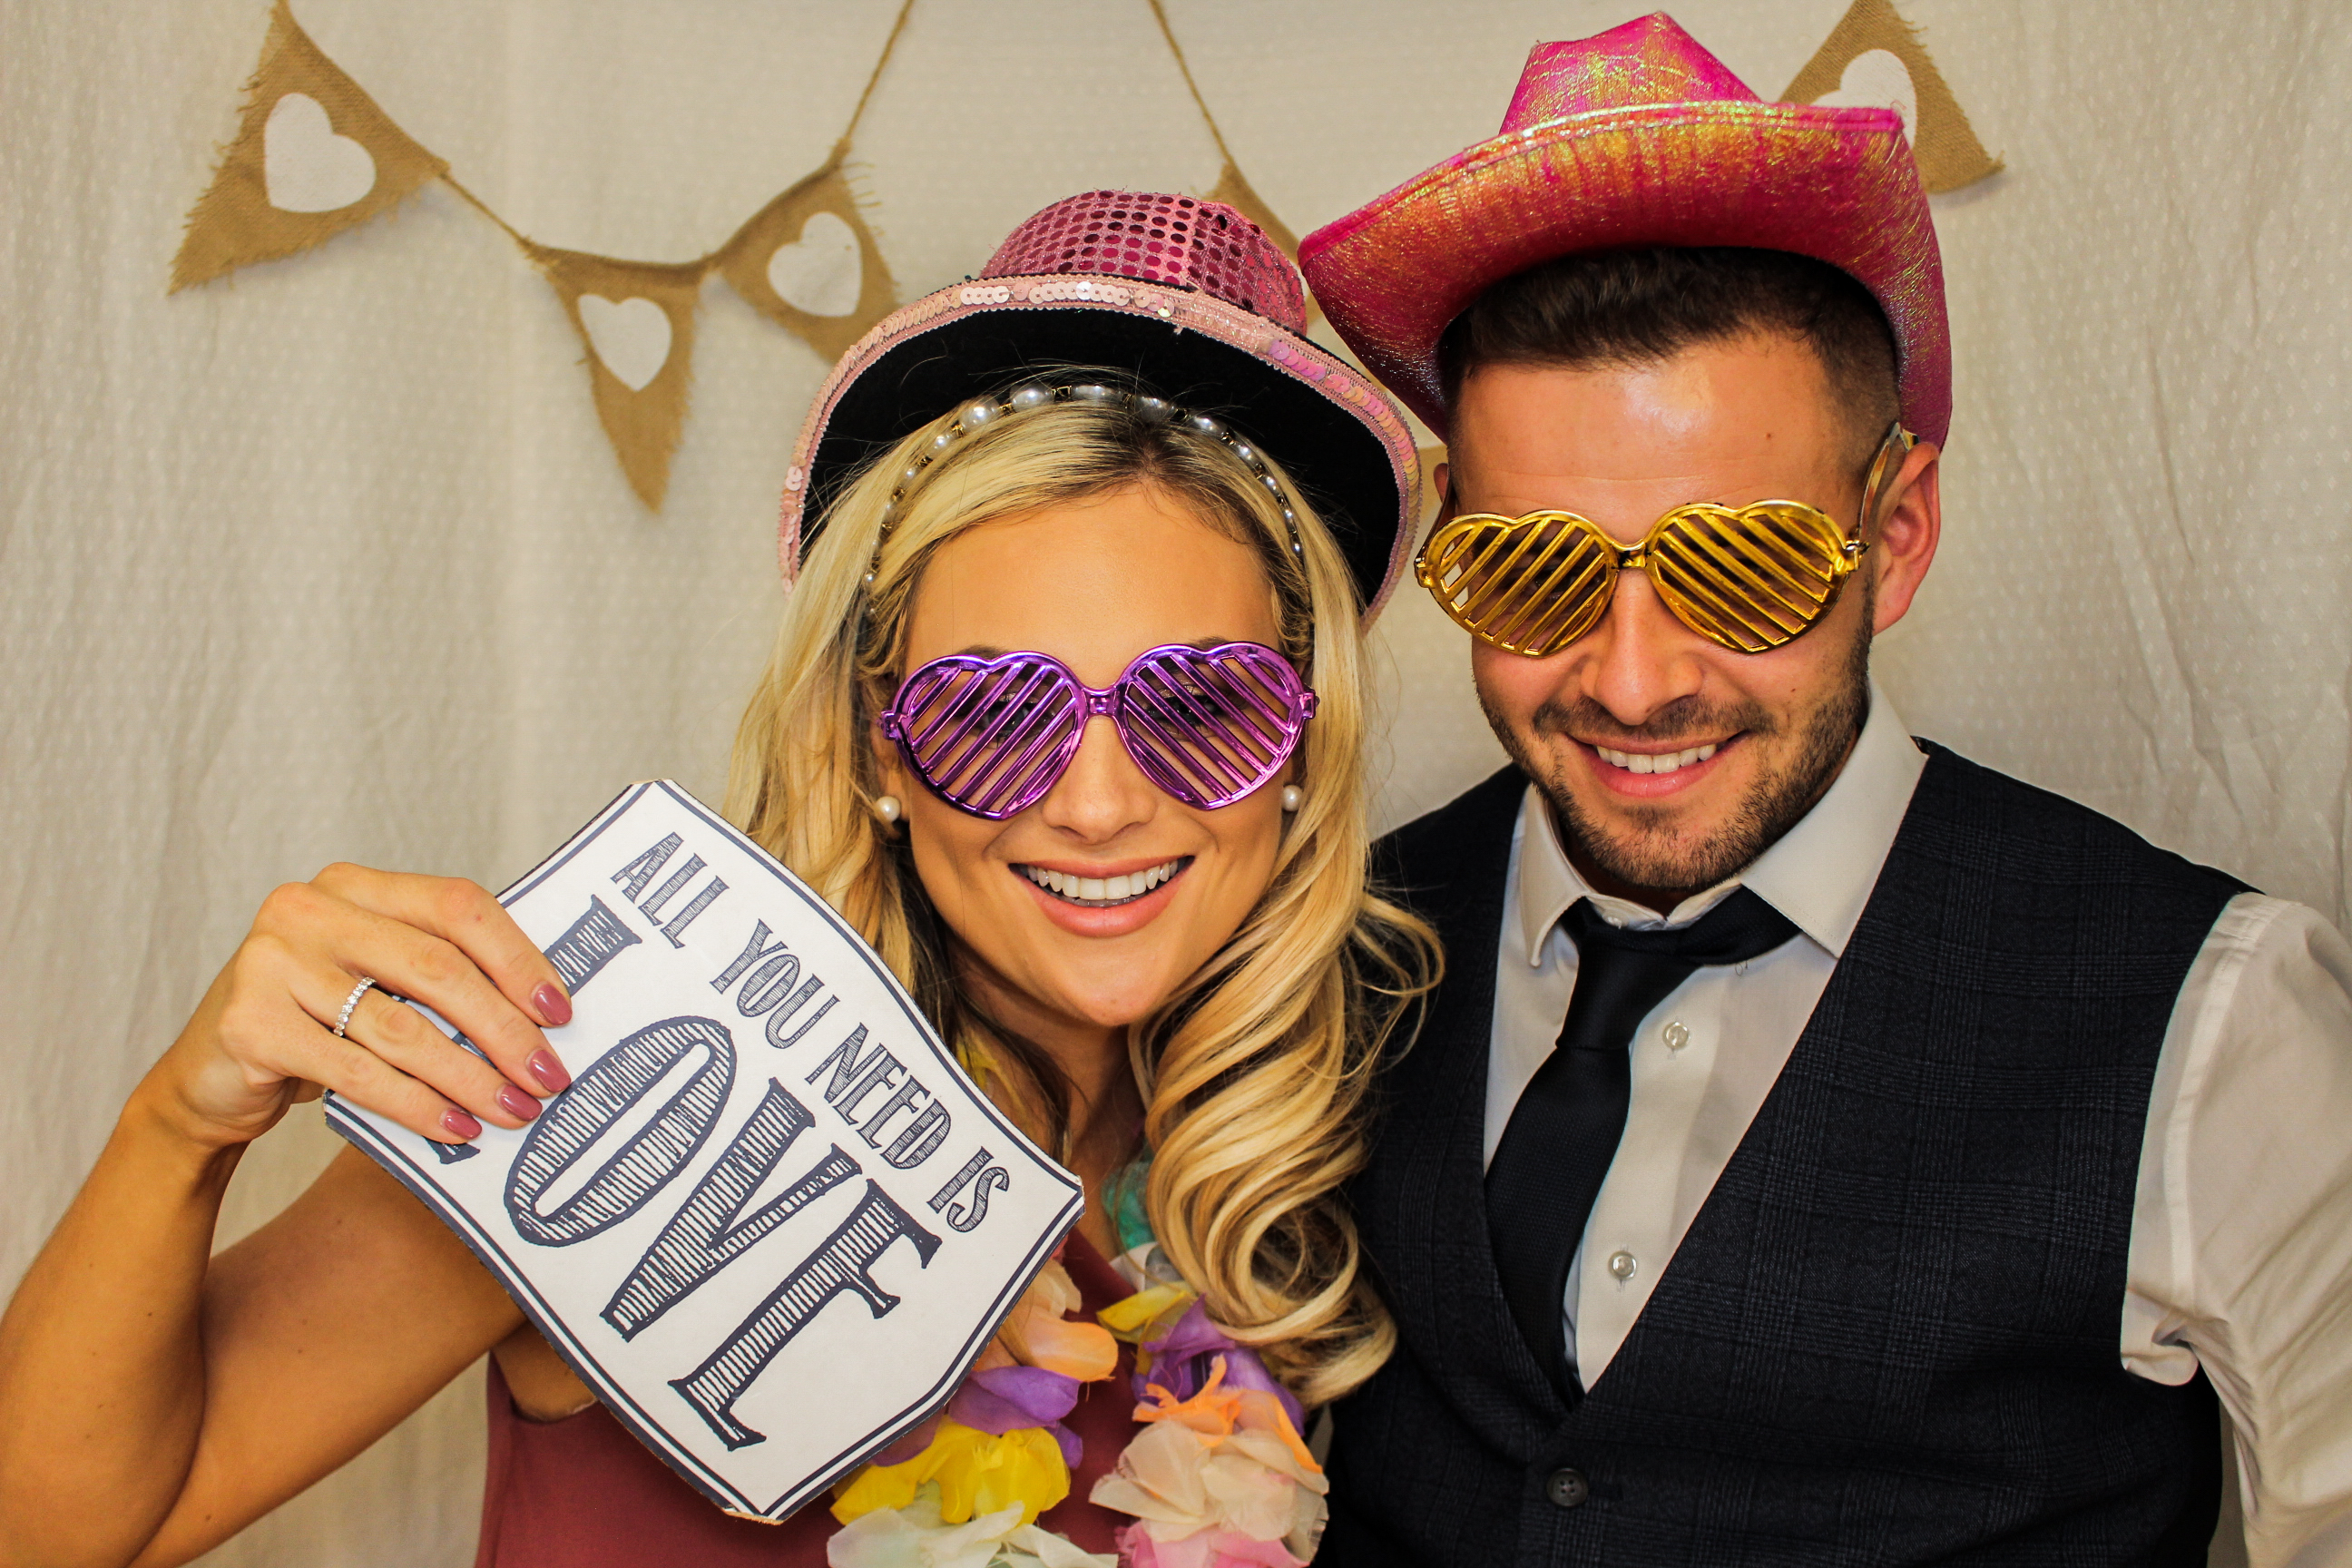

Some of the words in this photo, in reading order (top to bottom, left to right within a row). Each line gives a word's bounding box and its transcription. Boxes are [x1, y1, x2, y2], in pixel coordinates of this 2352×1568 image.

[610, 832, 729, 949] ALL
[710, 919, 840, 1050] YOU
[805, 1023, 952, 1170] NEED
[926, 1147, 1011, 1233] IS
